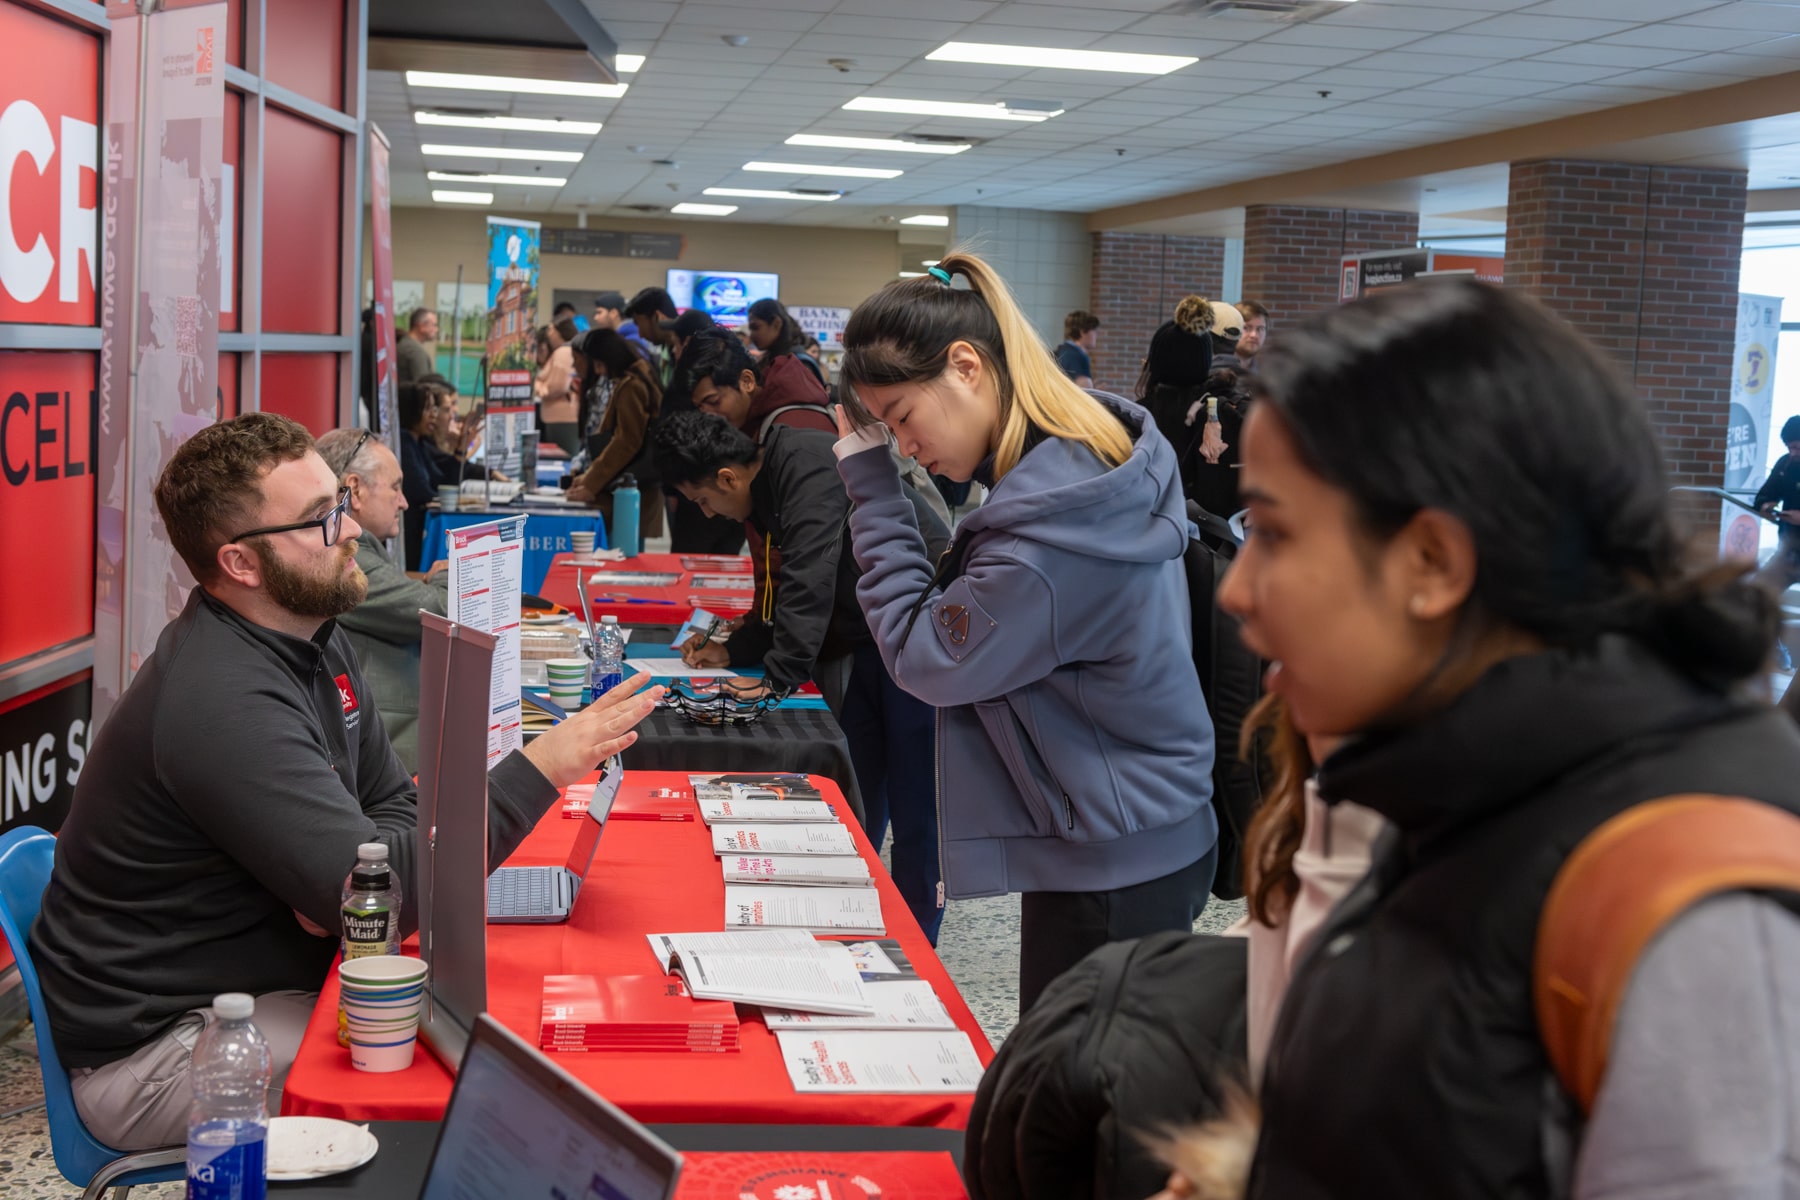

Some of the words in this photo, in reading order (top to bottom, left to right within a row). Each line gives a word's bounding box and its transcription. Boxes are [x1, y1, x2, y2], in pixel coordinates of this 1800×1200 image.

[799, 308, 840, 319] BANK
[803, 320, 848, 330] ACHINE
[1727, 424, 1750, 444] E'RE
[523, 536, 567, 551] BER
[66, 718, 93, 787] S
[344, 915, 385, 928] Minute
[350, 927, 379, 939] Maid
